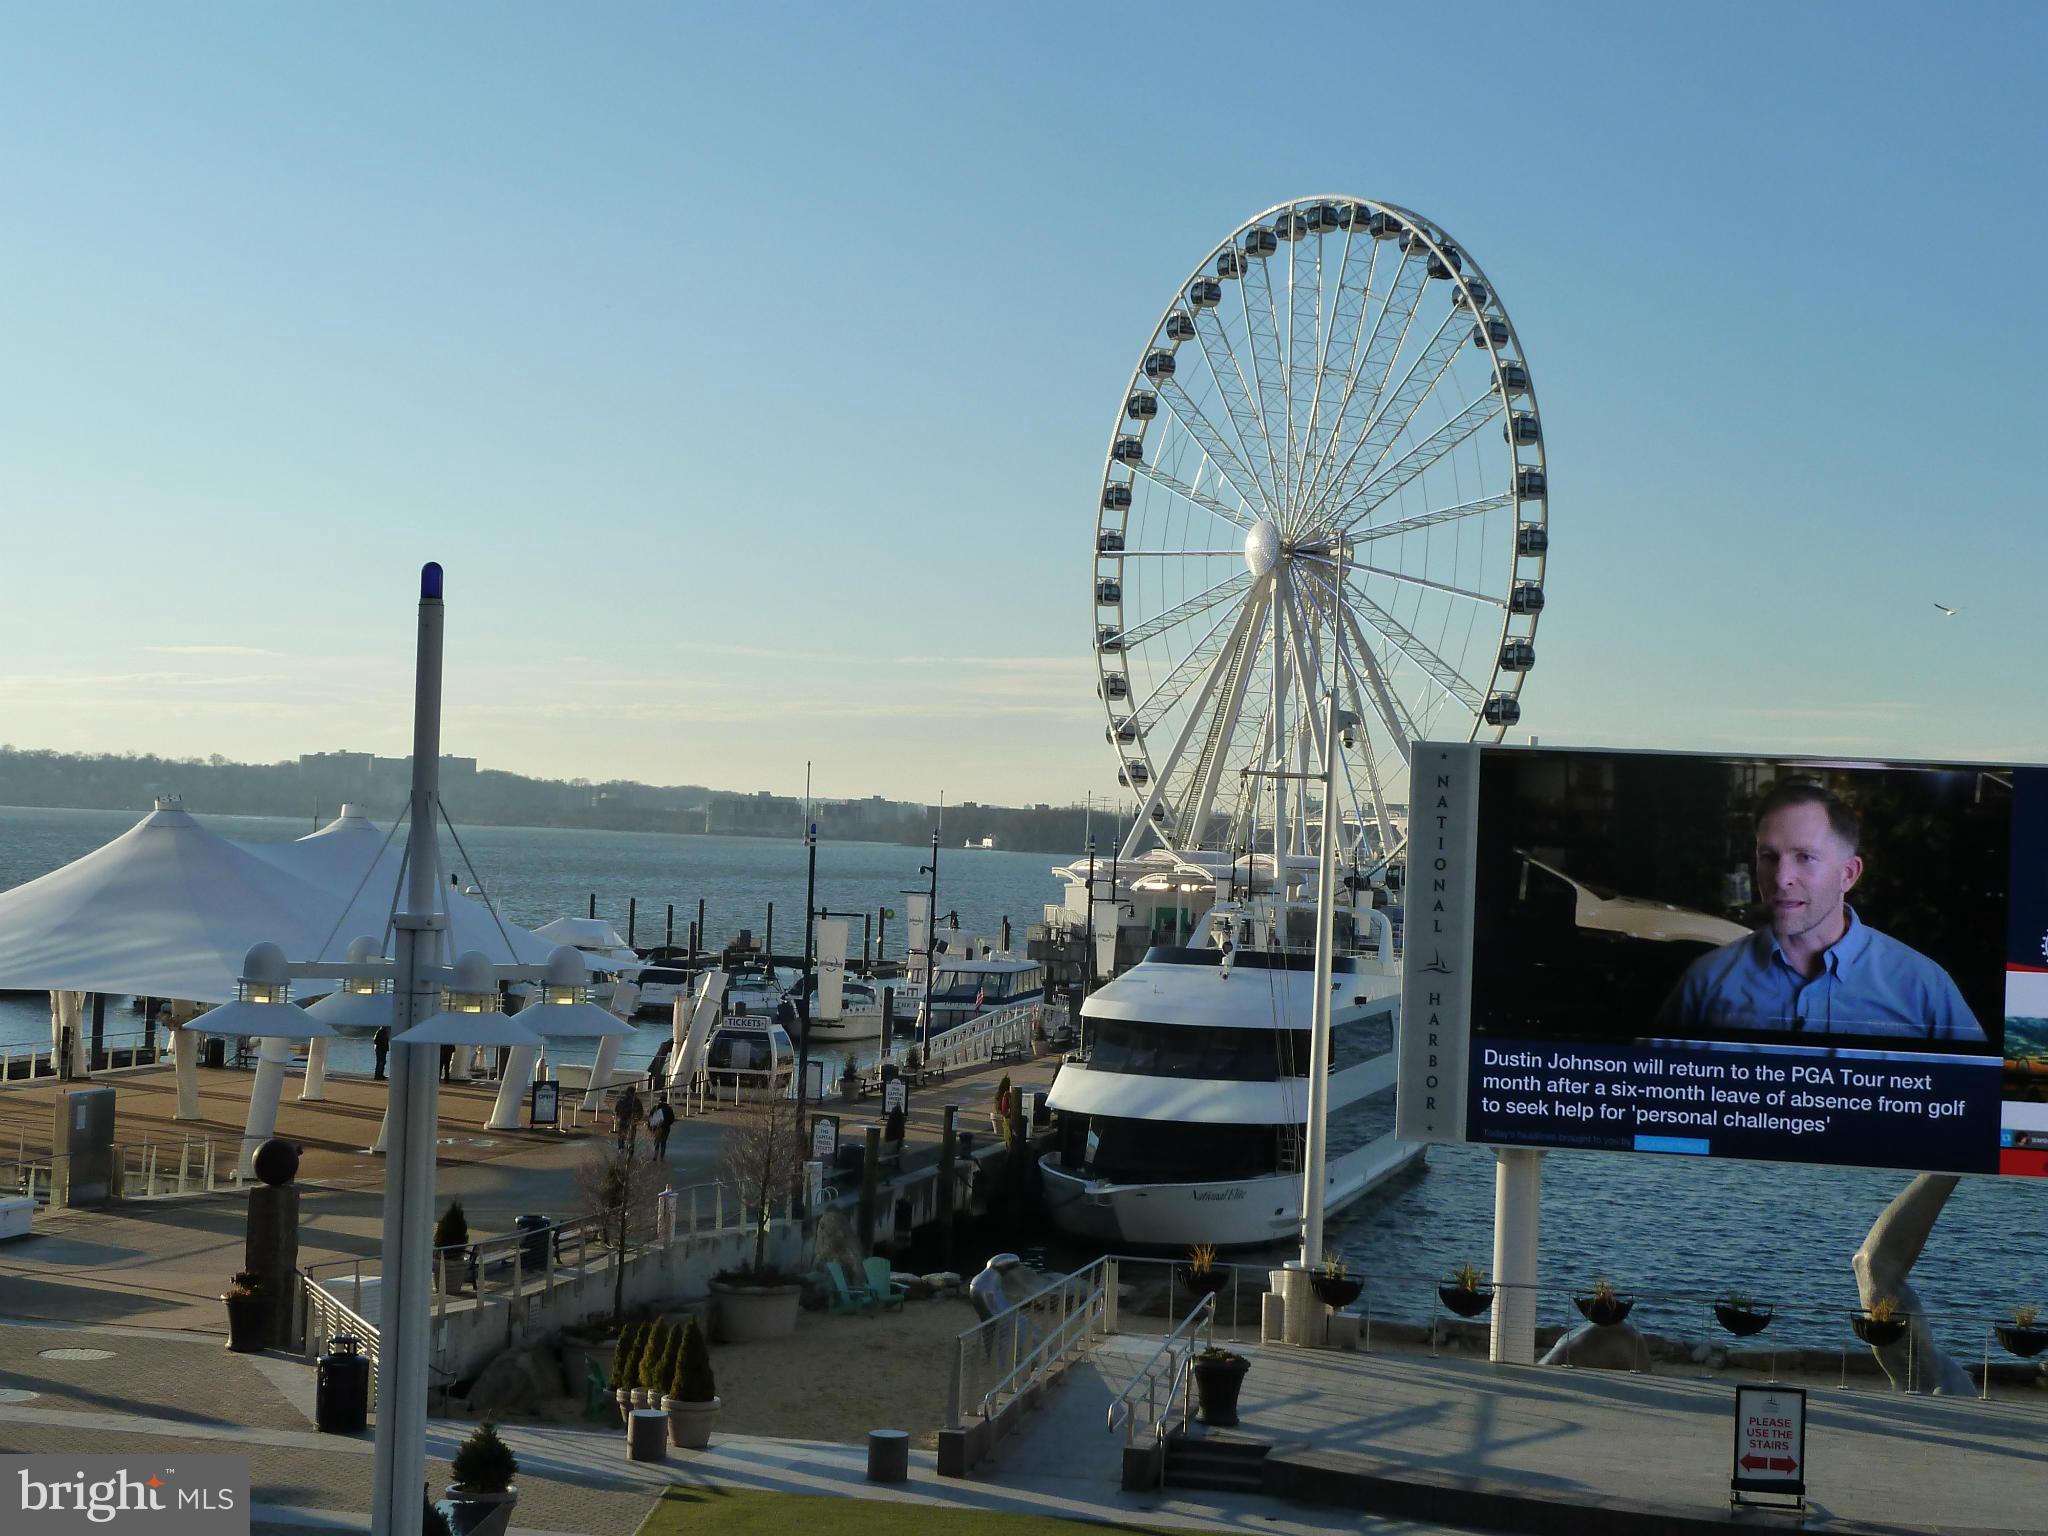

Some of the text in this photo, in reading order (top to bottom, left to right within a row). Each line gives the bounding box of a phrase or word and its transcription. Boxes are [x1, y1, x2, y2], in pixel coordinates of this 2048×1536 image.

[1433, 775, 1449, 933] NATIONAL
[727, 1018, 761, 1027] TICKETS
[1425, 992, 1441, 1110] HARBOR
[1484, 1048, 1933, 1091] Dustin Johnson will return to the PGA Tour next
[1482, 1075, 1967, 1118] month after a six-month leave of absence from golf
[1481, 1097, 1831, 1135] to seek help for 'personal challenges'
[1746, 1428, 1793, 1440] USE THE
[1749, 1416, 1792, 1428] PLEASE
[1749, 1439, 1790, 1451] STAIRS
